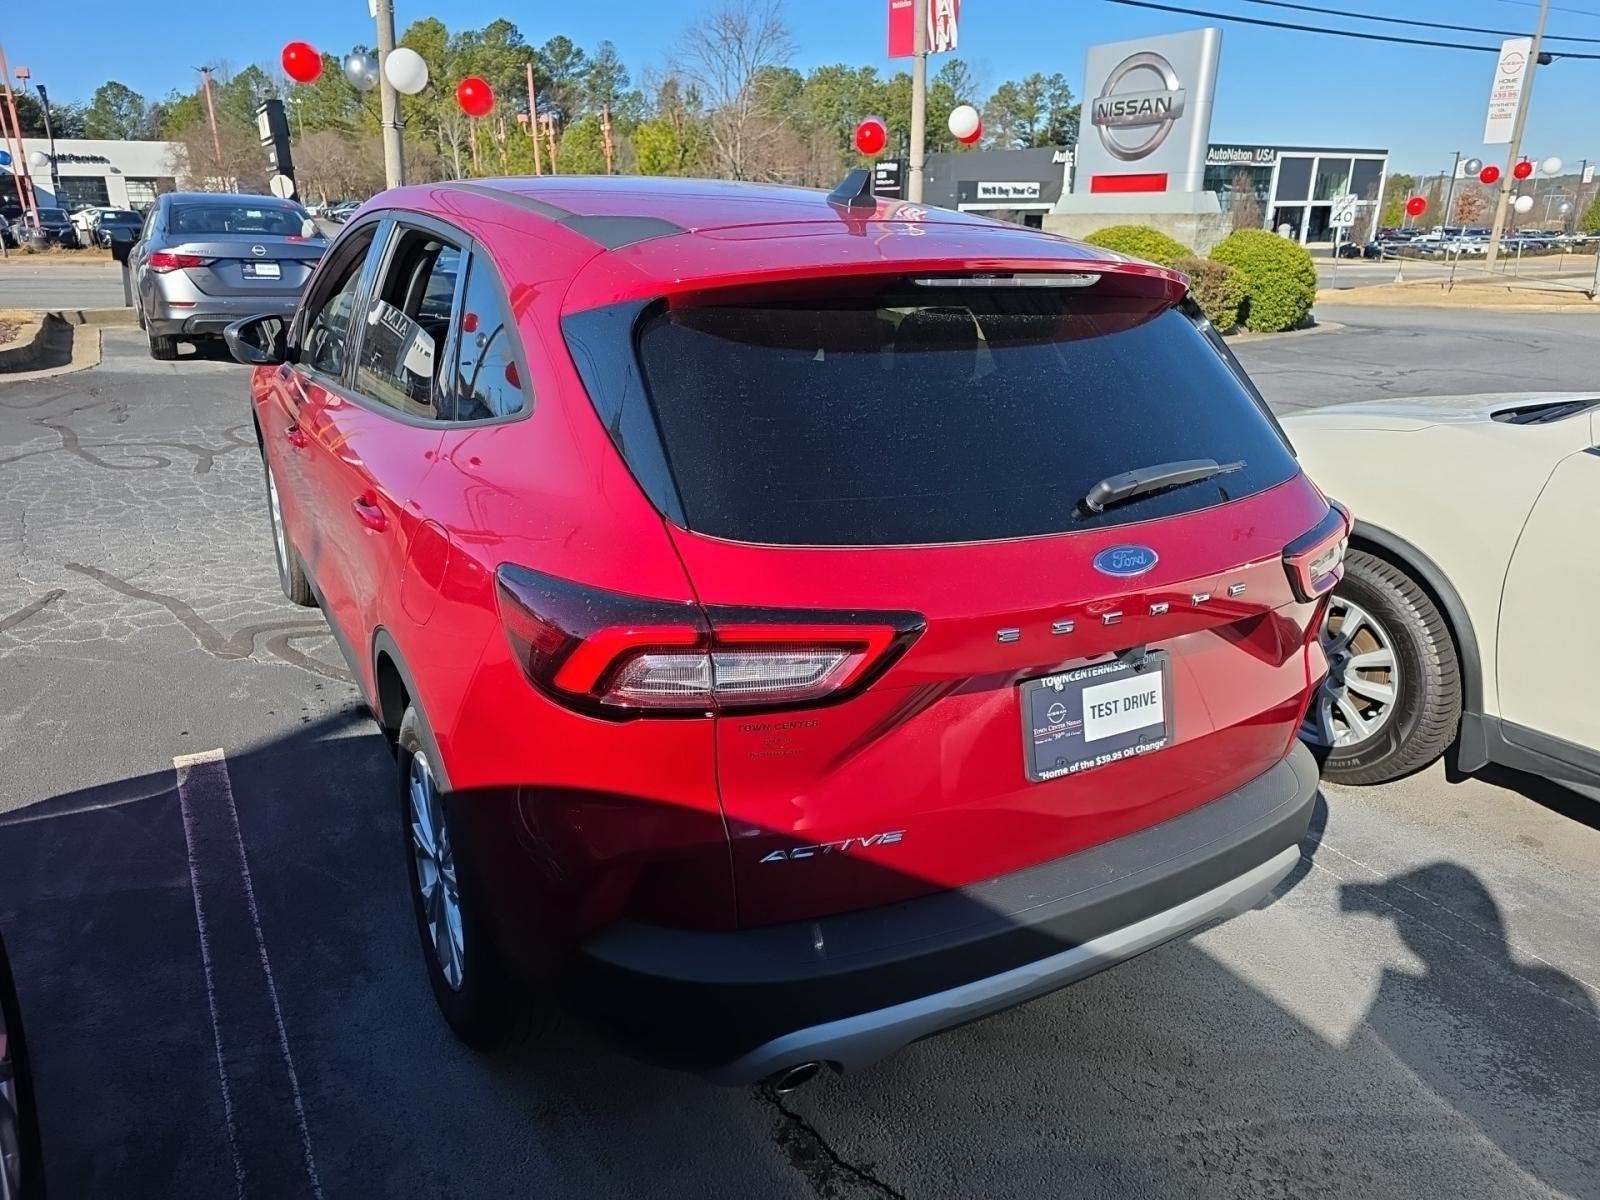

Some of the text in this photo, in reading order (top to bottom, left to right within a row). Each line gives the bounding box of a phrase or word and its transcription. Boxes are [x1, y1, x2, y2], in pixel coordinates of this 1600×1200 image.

[1097, 96, 1171, 118] NISSAN
[1208, 147, 1275, 161] AutoNation USA
[998, 186, 1010, 198] Buy
[1011, 186, 1026, 196] Your
[1027, 186, 1038, 196] Car
[1333, 211, 1353, 222] 40
[1112, 549, 1148, 569] Ford
[997, 582, 1246, 643] ESCAPE
[1090, 690, 1157, 720] TEST DRIVE
[738, 719, 819, 733] TOWN CENTER
[1038, 738, 1168, 780] "Home of the $39.95 Oil Change"
[760, 829, 907, 863] ACTIVE
